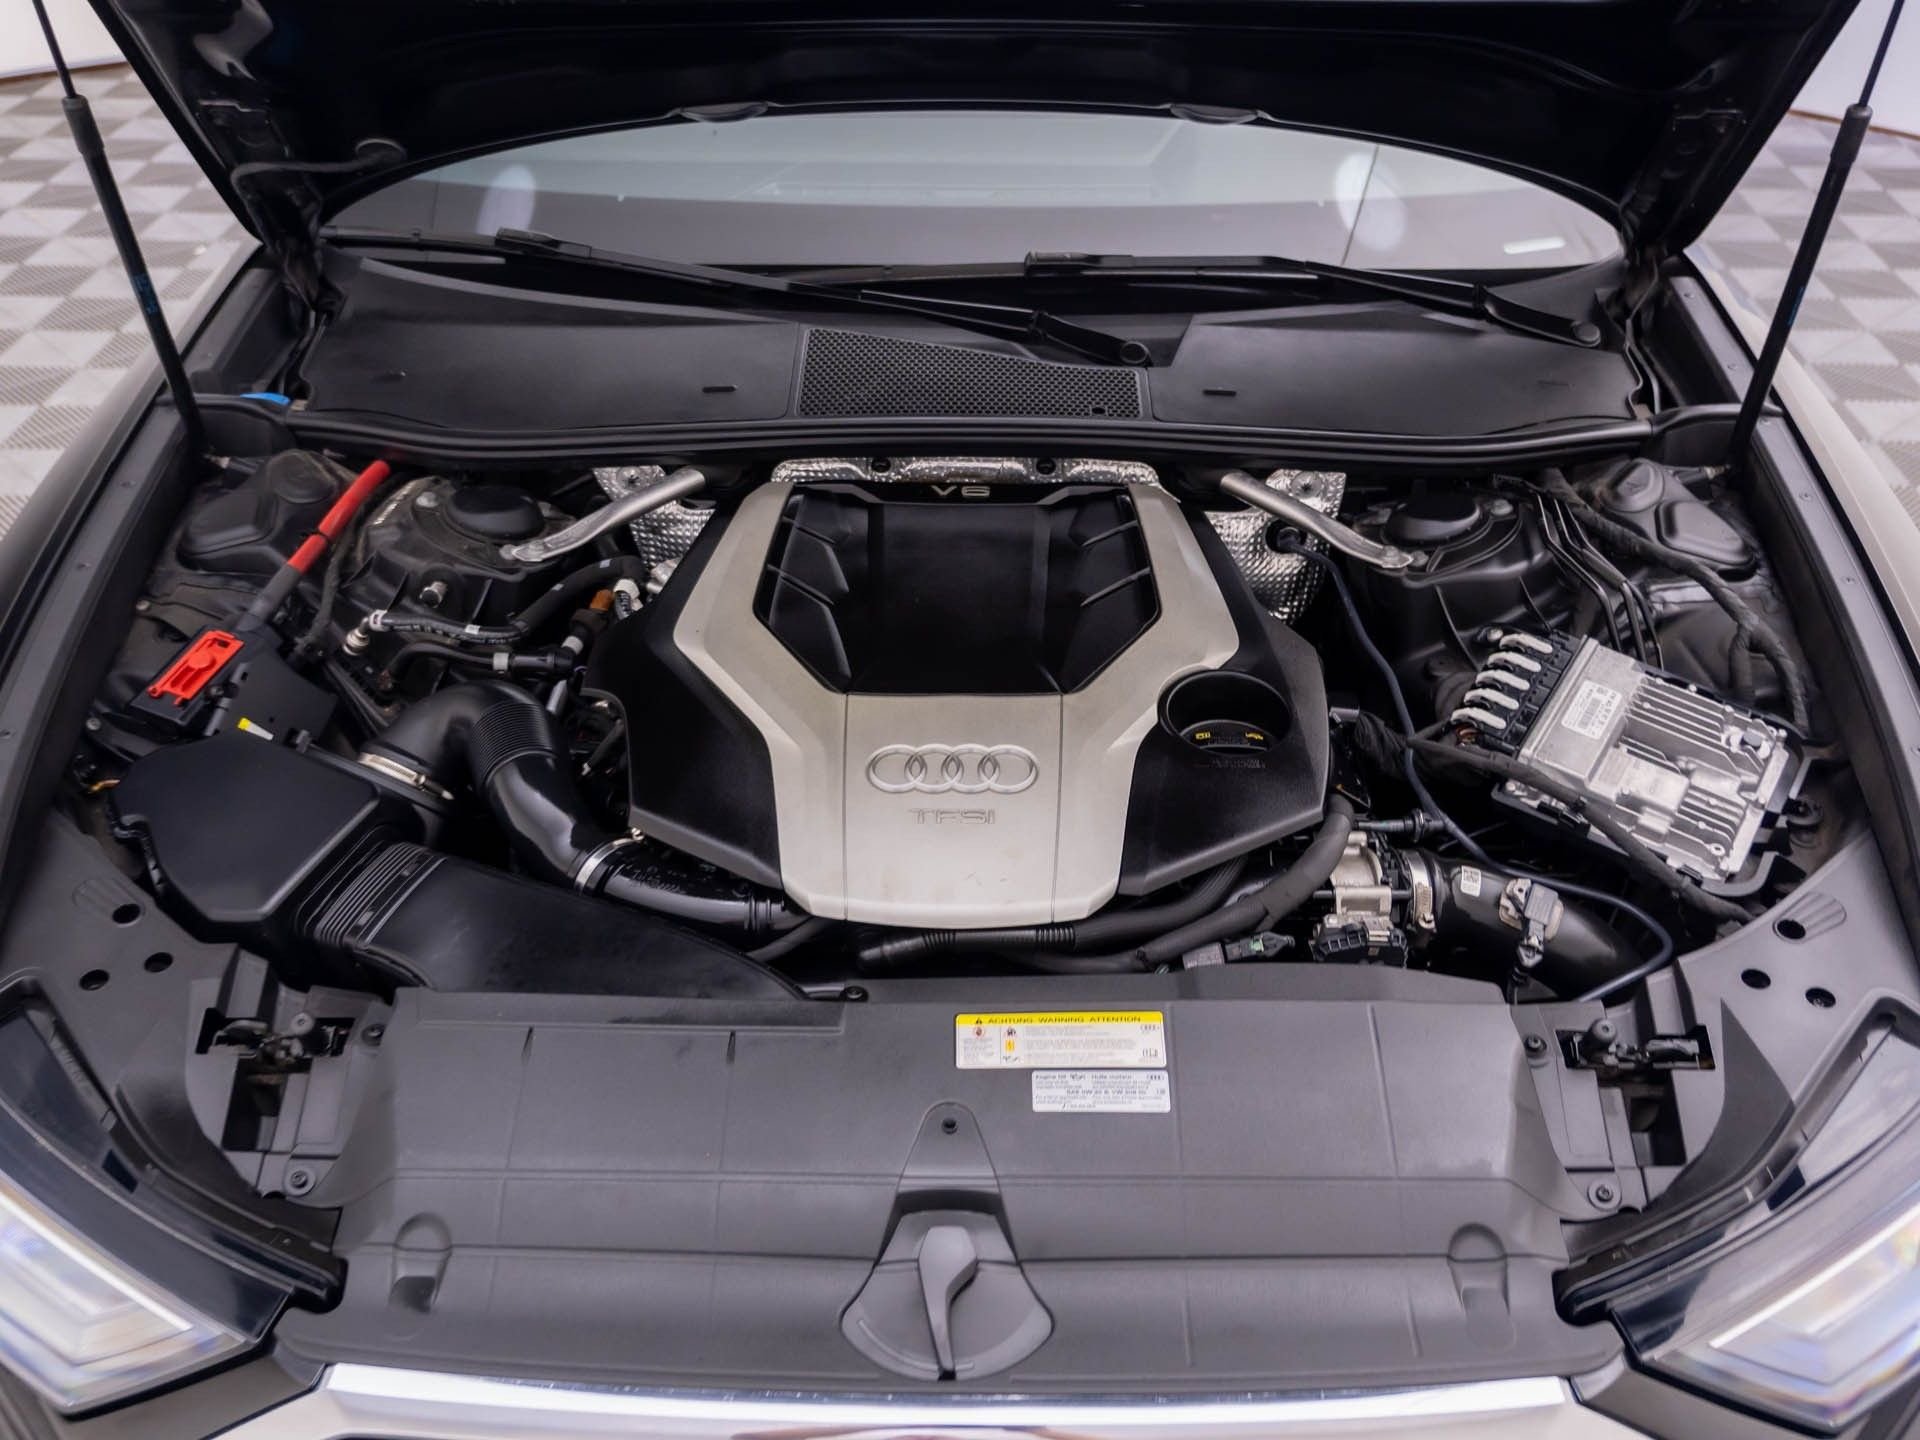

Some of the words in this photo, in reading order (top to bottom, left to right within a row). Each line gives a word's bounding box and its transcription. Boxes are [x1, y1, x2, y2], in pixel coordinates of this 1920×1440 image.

[931, 485, 991, 498] V6
[908, 808, 996, 825] TFSI
[987, 1017, 1034, 1025] ACHTUNG
[1038, 1016, 1085, 1025] WARNING
[1089, 1015, 1142, 1024] ATTENTION
